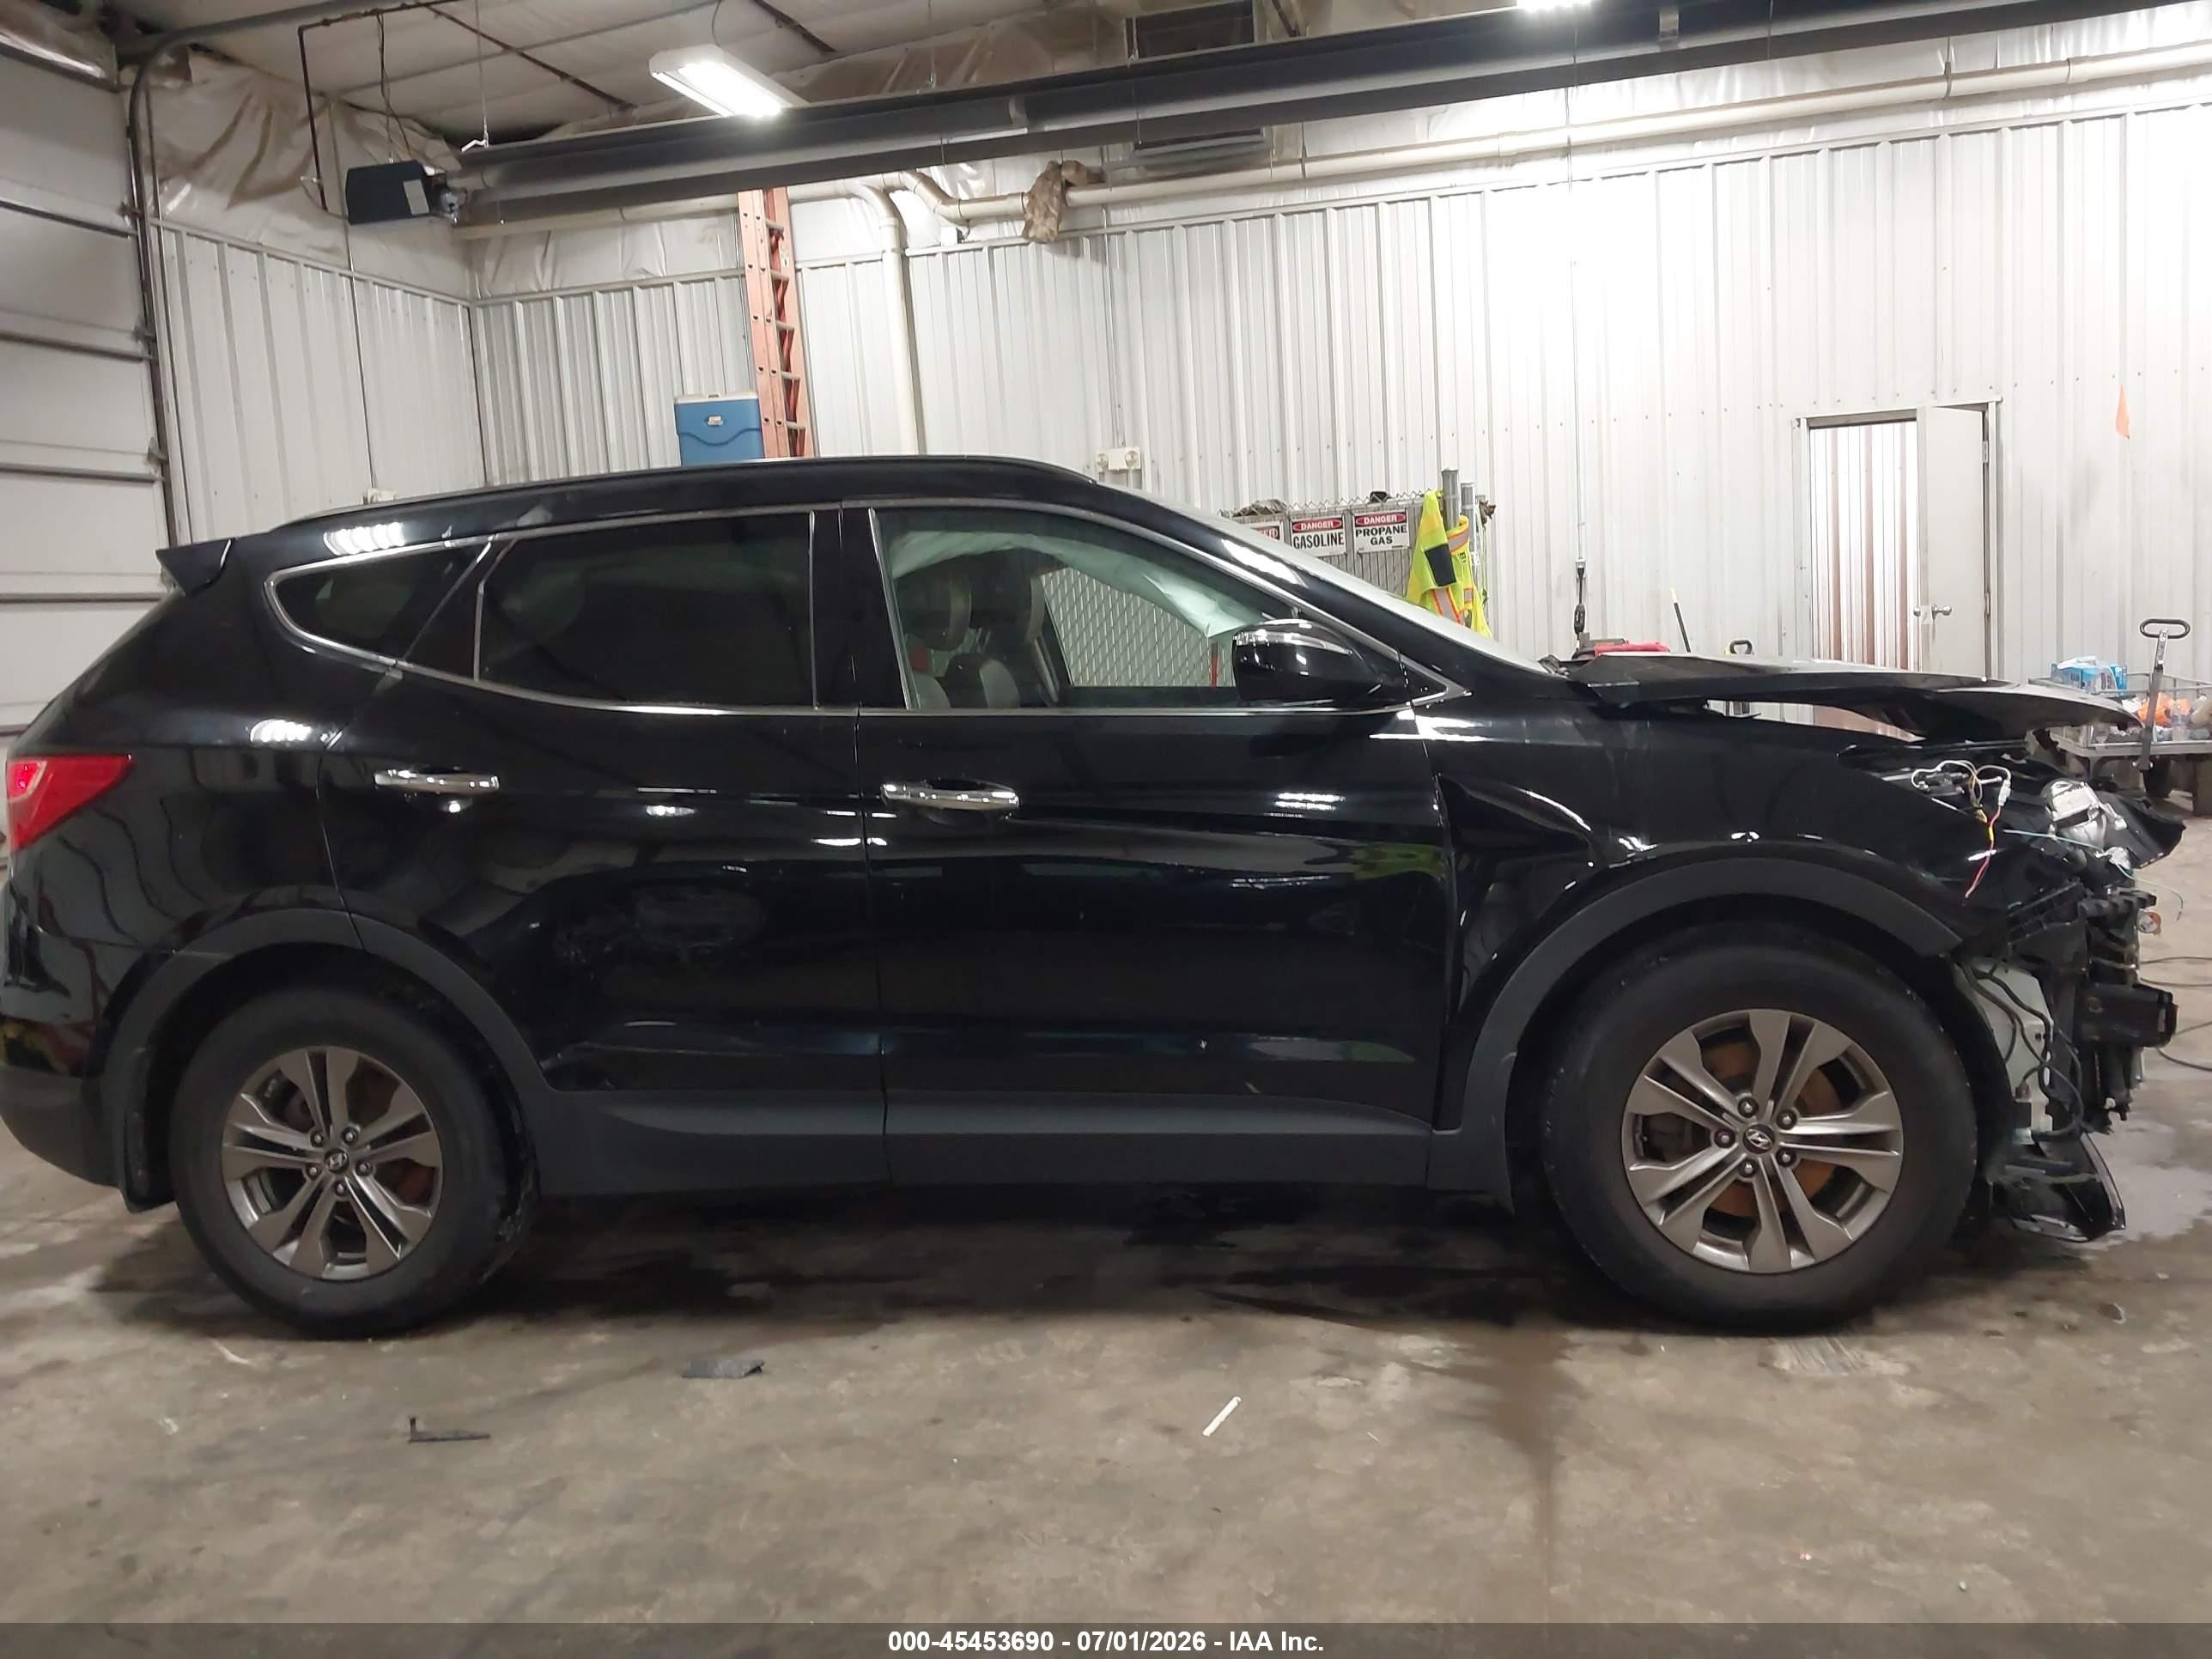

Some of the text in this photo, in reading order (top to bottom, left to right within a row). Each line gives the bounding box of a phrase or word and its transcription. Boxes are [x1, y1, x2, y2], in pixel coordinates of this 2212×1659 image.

[1300, 520, 1334, 531] DANGER
[1364, 514, 1398, 526] DANGER
[1355, 524, 1407, 538] PROPANE
[1292, 532, 1345, 550] GASOLINE
[1370, 536, 1393, 546] GAS
